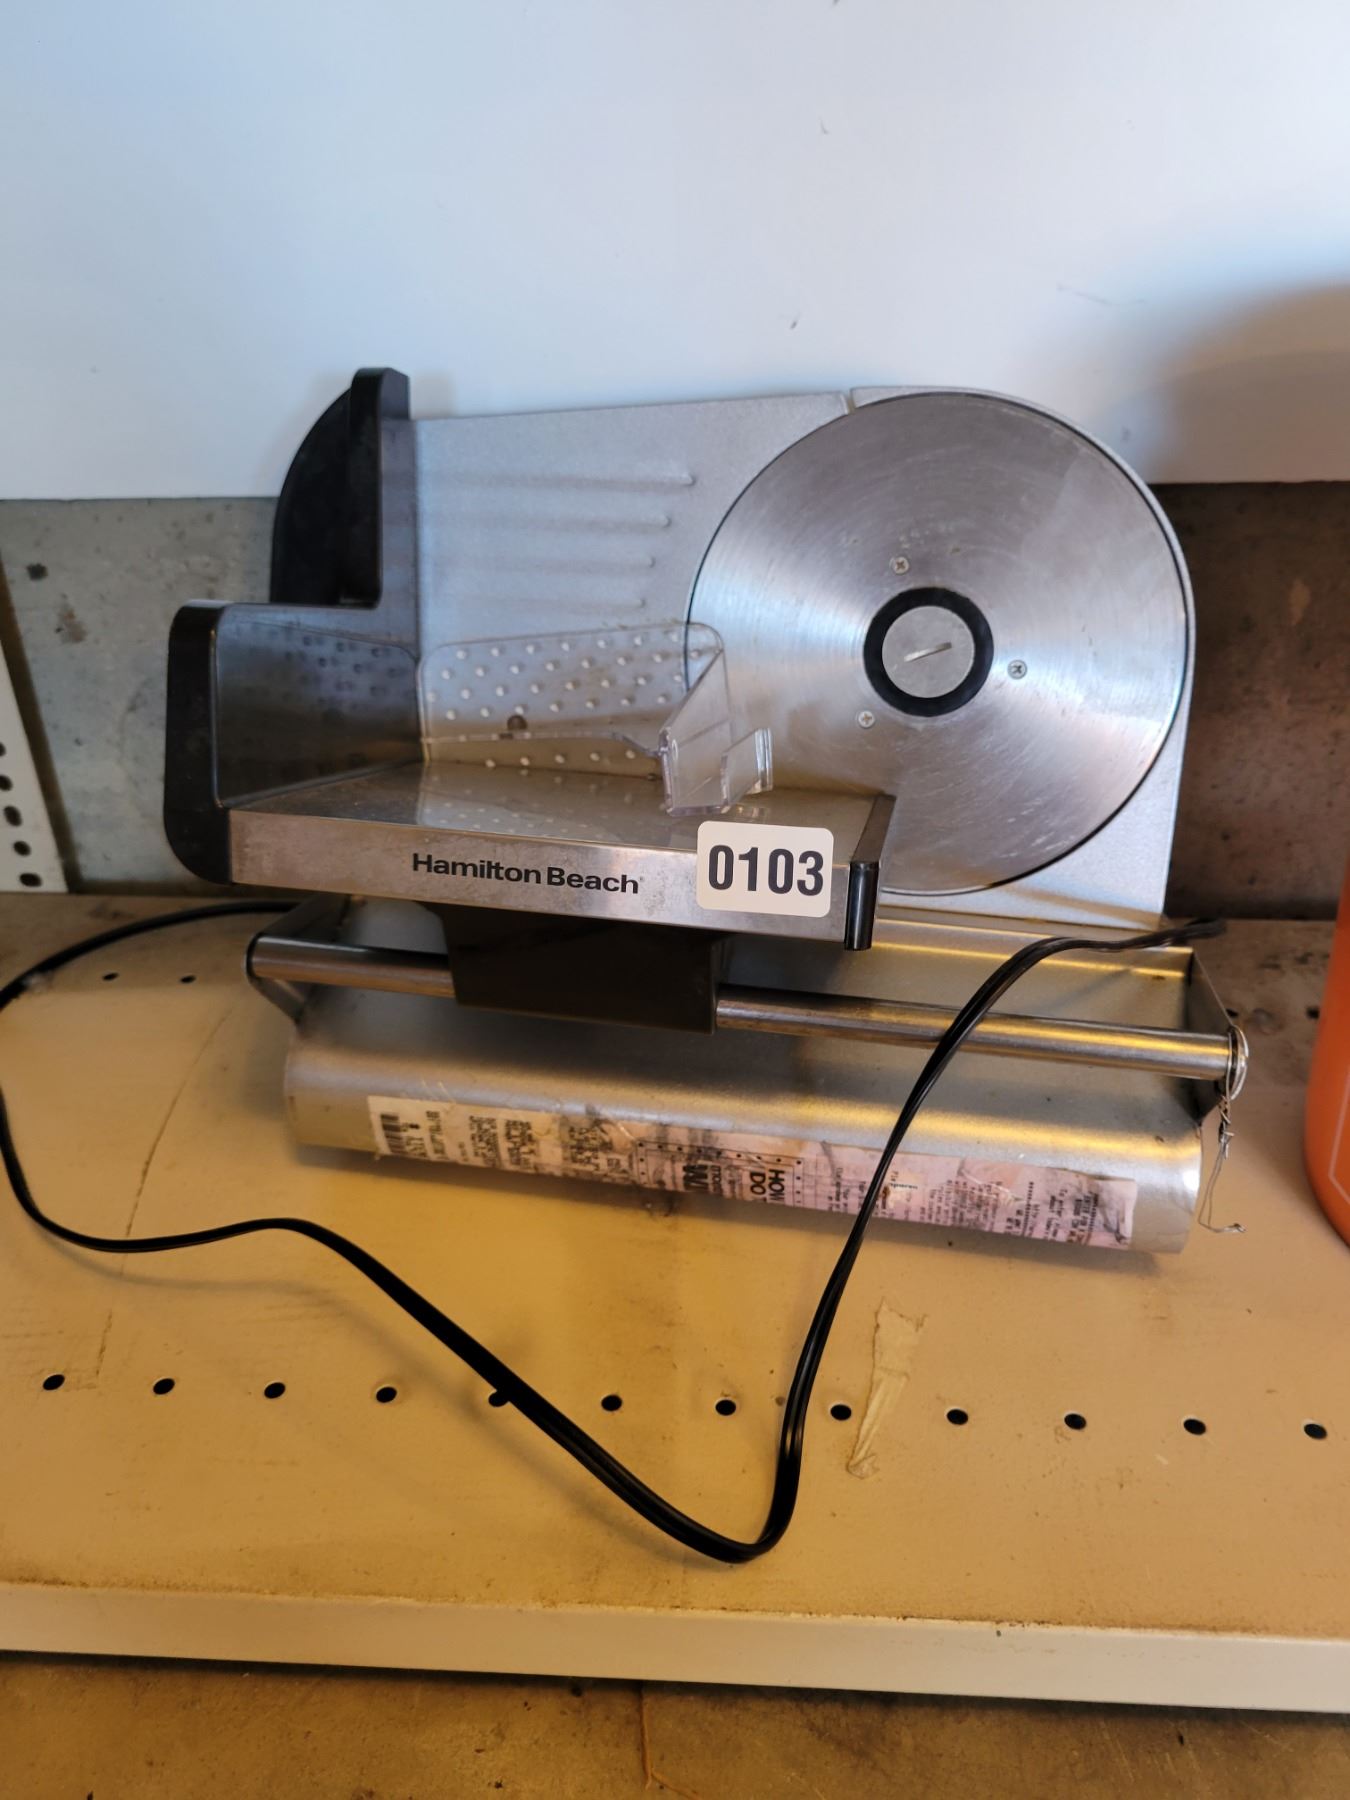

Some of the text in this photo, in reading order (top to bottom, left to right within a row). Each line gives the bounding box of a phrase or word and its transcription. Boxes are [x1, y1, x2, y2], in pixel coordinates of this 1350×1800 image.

[411, 853, 640, 895] Hamilton Beach
[708, 844, 825, 896] 0103
